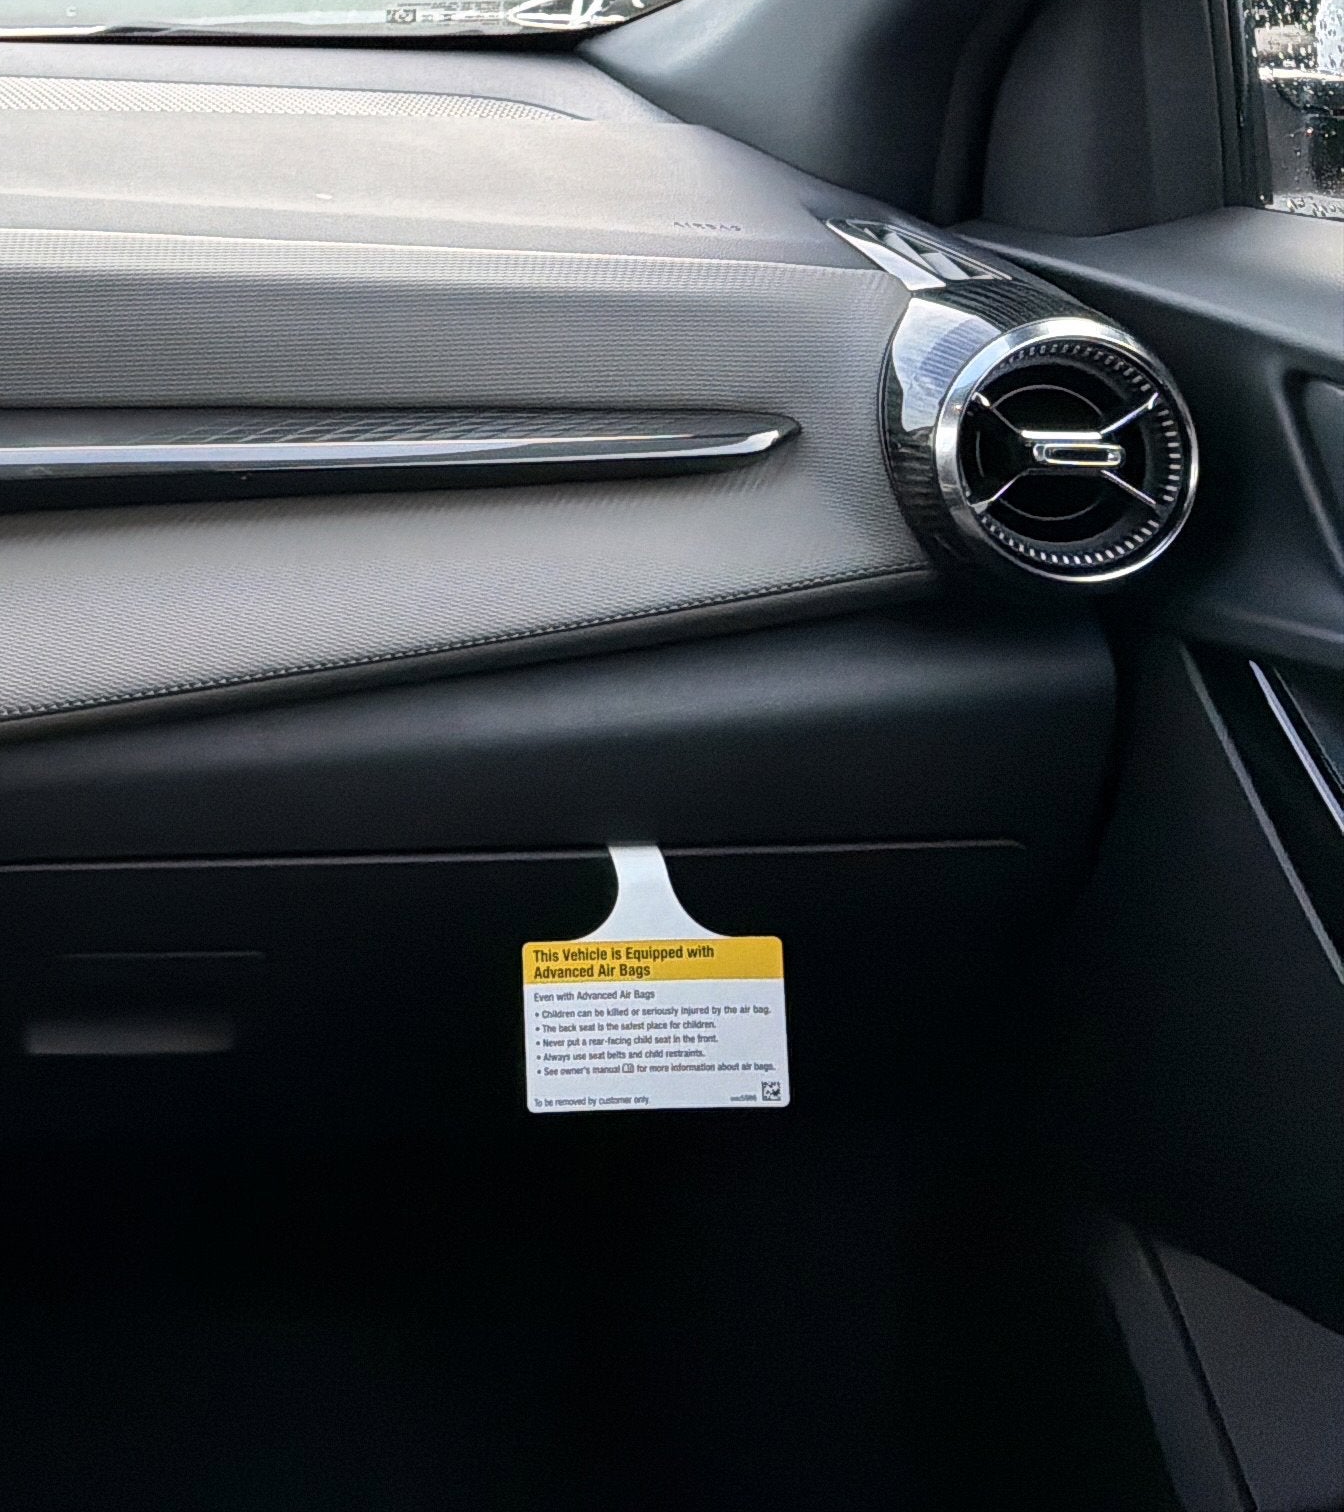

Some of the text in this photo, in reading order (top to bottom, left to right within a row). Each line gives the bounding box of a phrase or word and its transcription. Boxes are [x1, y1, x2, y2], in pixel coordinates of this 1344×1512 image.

[533, 944, 714, 963] This Vehicle is Equipped with
[533, 964, 651, 979] Advanced Air Bags
[533, 990, 655, 1003] Even with Advanced Air Bags
[542, 1009, 575, 1019] Children
[577, 1010, 592, 1018] can
[594, 1008, 605, 1017] be
[606, 1008, 629, 1016] killed
[642, 1006, 679, 1018] seriously
[680, 1006, 709, 1016] injured
[712, 1006, 722, 1016] by
[724, 1005, 738, 1014] the
[740, 1004, 750, 1014] air
[753, 1004, 772, 1016] bag.
[542, 1020, 717, 1033] The back seat is the safest place for children.
[542, 1034, 719, 1048] Never put rear-facing child seat in the front.
[543, 1048, 706, 1062] Always use seat belts and child restraints.
[543, 1061, 777, 1076] See owner's manual for more information about air bags.
[534, 1096, 632, 1107] To be removed by customer
